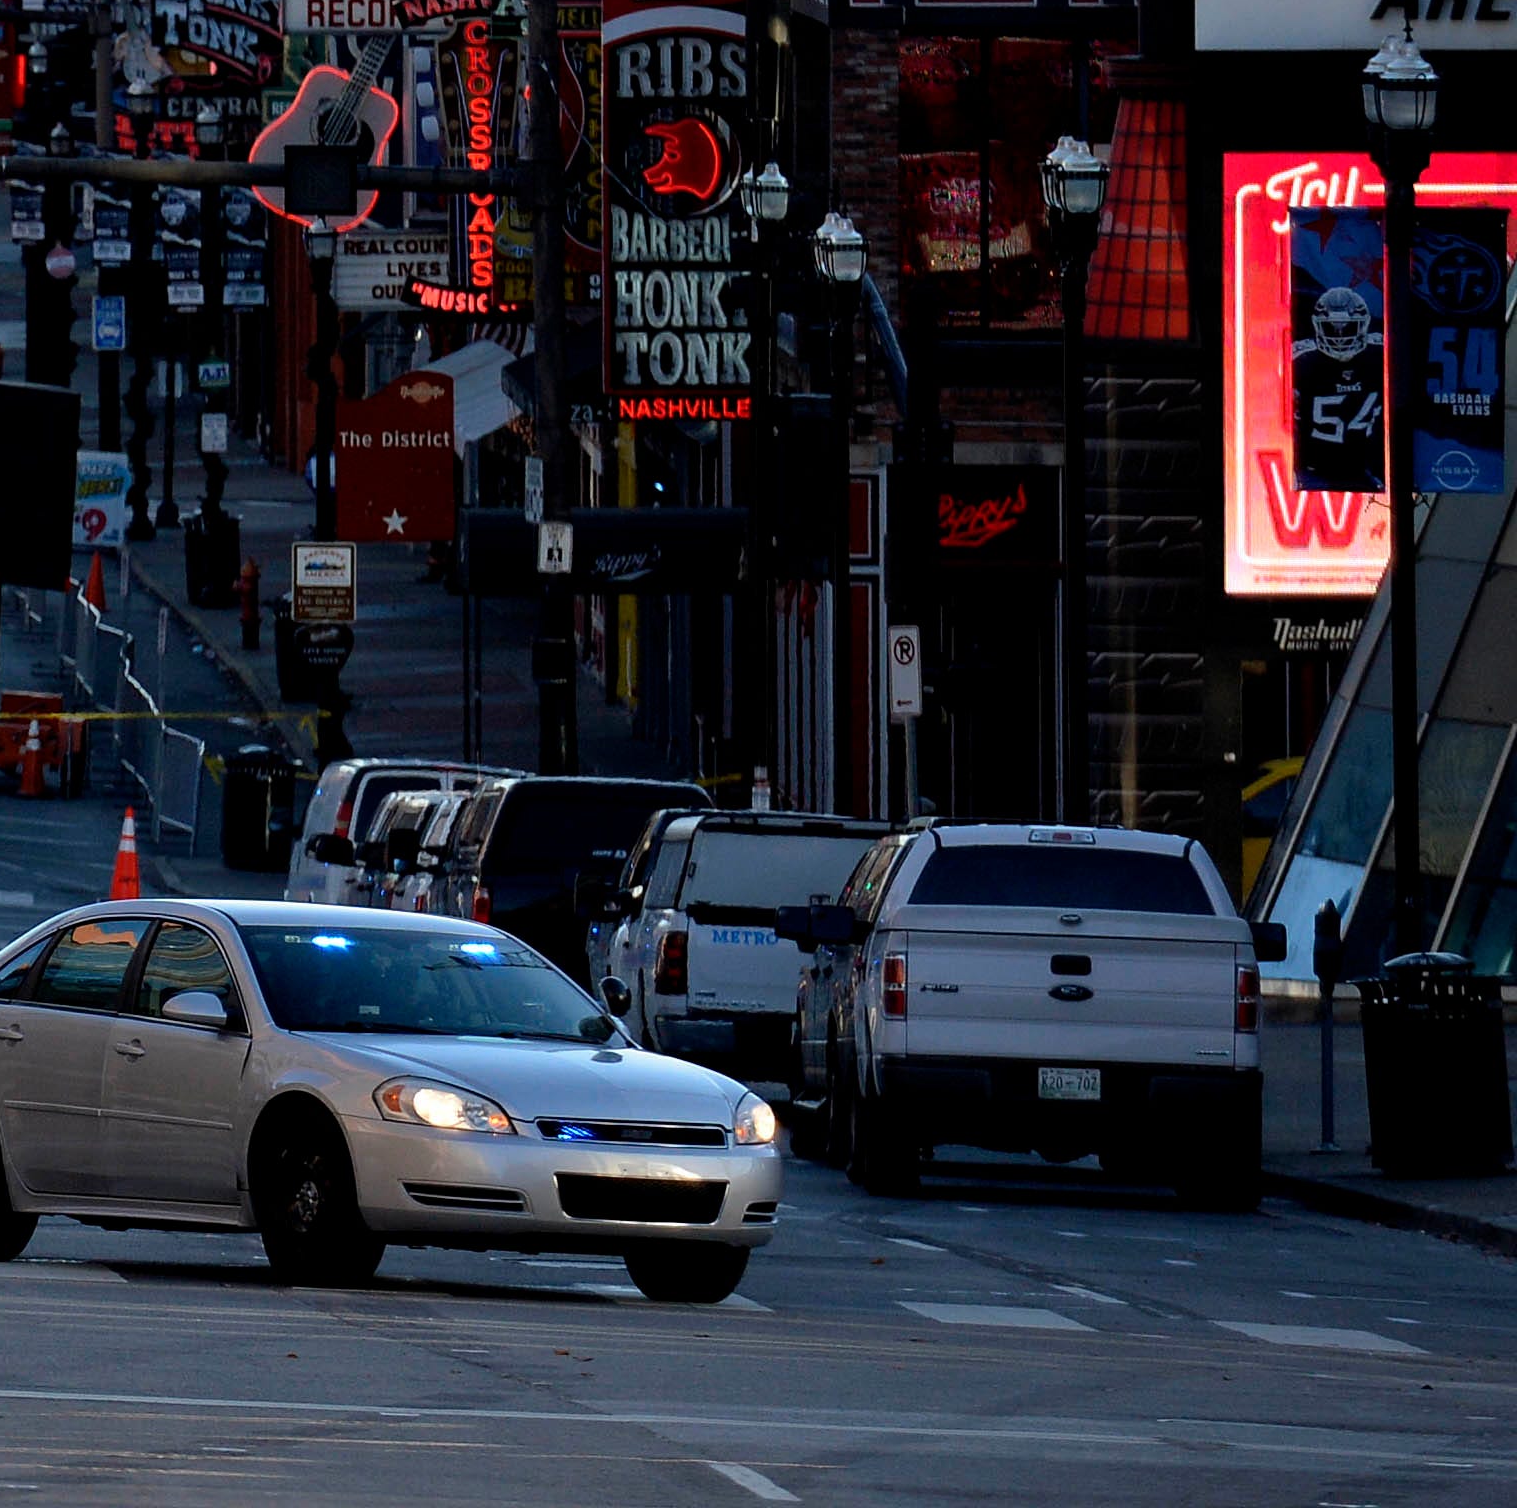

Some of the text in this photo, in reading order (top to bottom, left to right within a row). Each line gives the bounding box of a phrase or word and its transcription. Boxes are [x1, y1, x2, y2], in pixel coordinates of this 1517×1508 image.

[615, 36, 748, 99] RIBS
[165, 94, 262, 118] CENTRA
[343, 239, 390, 255] REAL
[386, 261, 441, 277] LIVES
[614, 269, 753, 329] HONK
[615, 330, 752, 386] TONK
[1425, 326, 1499, 397] 54
[618, 397, 752, 420] NASHVILLE
[1310, 392, 1383, 444] 54
[1451, 405, 1492, 417] EVANS
[339, 429, 452, 449] The District
[1430, 465, 1481, 476] NISSAN
[712, 929, 780, 945] METRO
